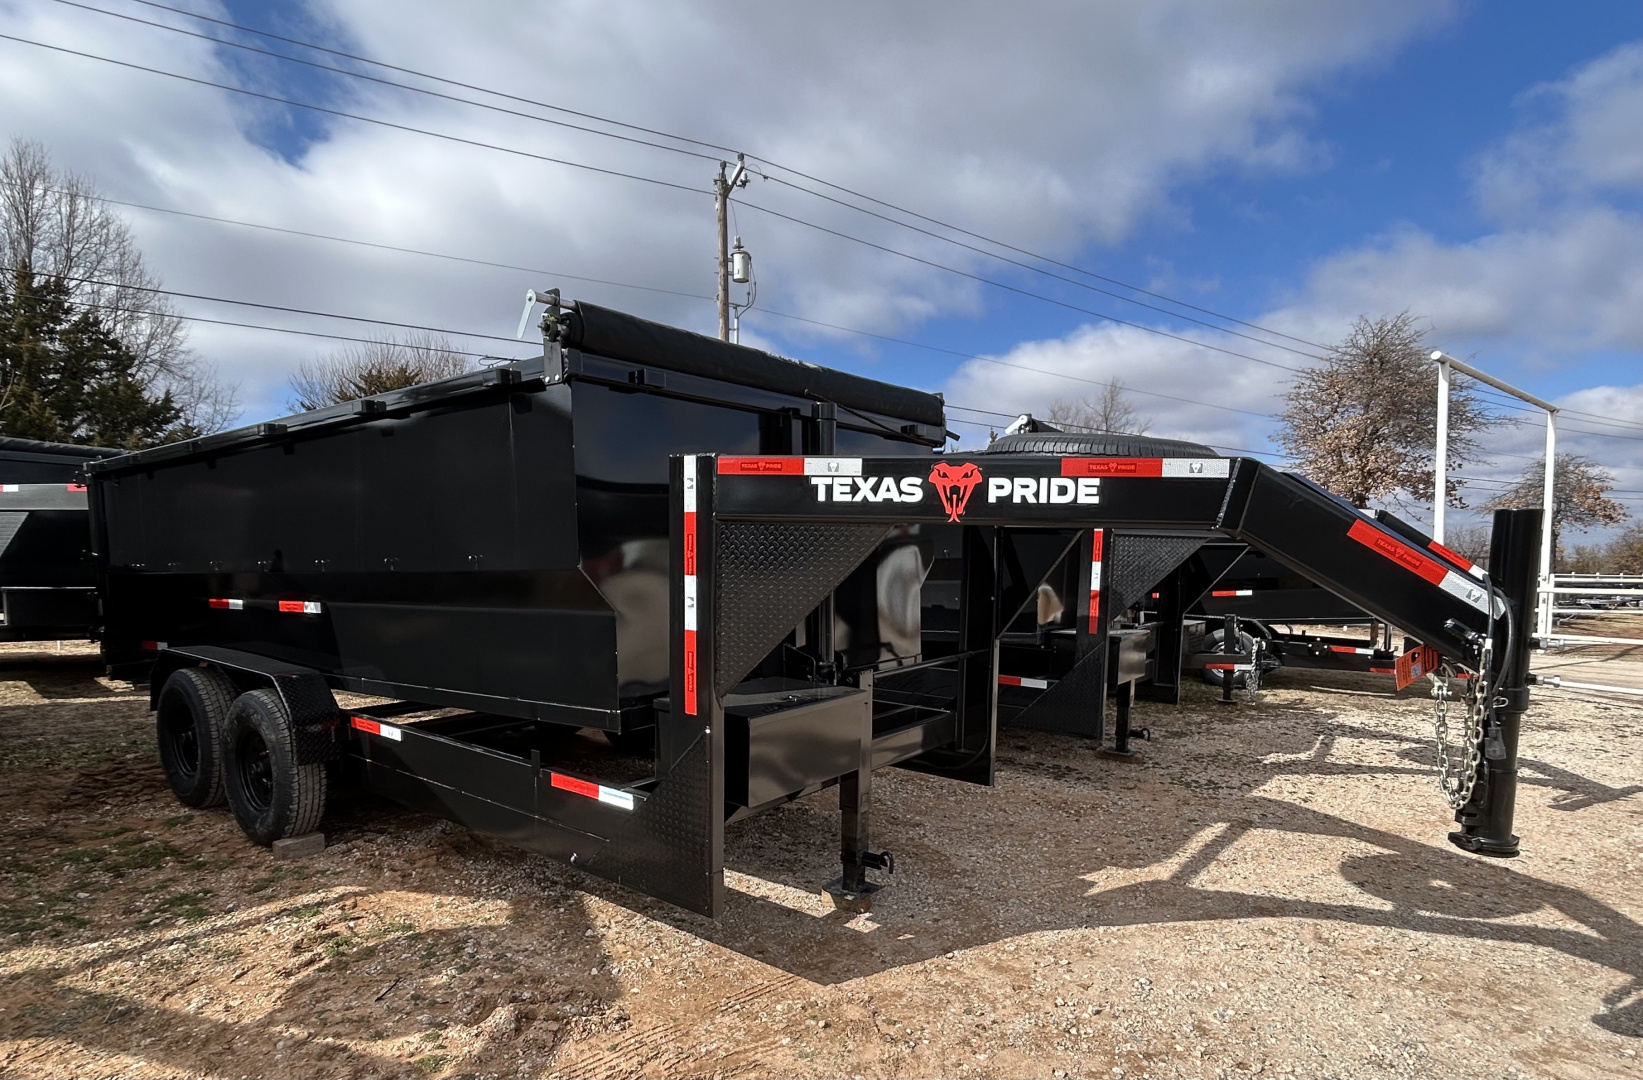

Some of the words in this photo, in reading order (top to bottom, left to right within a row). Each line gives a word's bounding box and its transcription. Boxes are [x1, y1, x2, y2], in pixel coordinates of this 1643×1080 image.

[811, 476, 923, 502] TEXAS
[987, 477, 1100, 504] PRIDE
[1377, 539, 1395, 552] TEXAS
